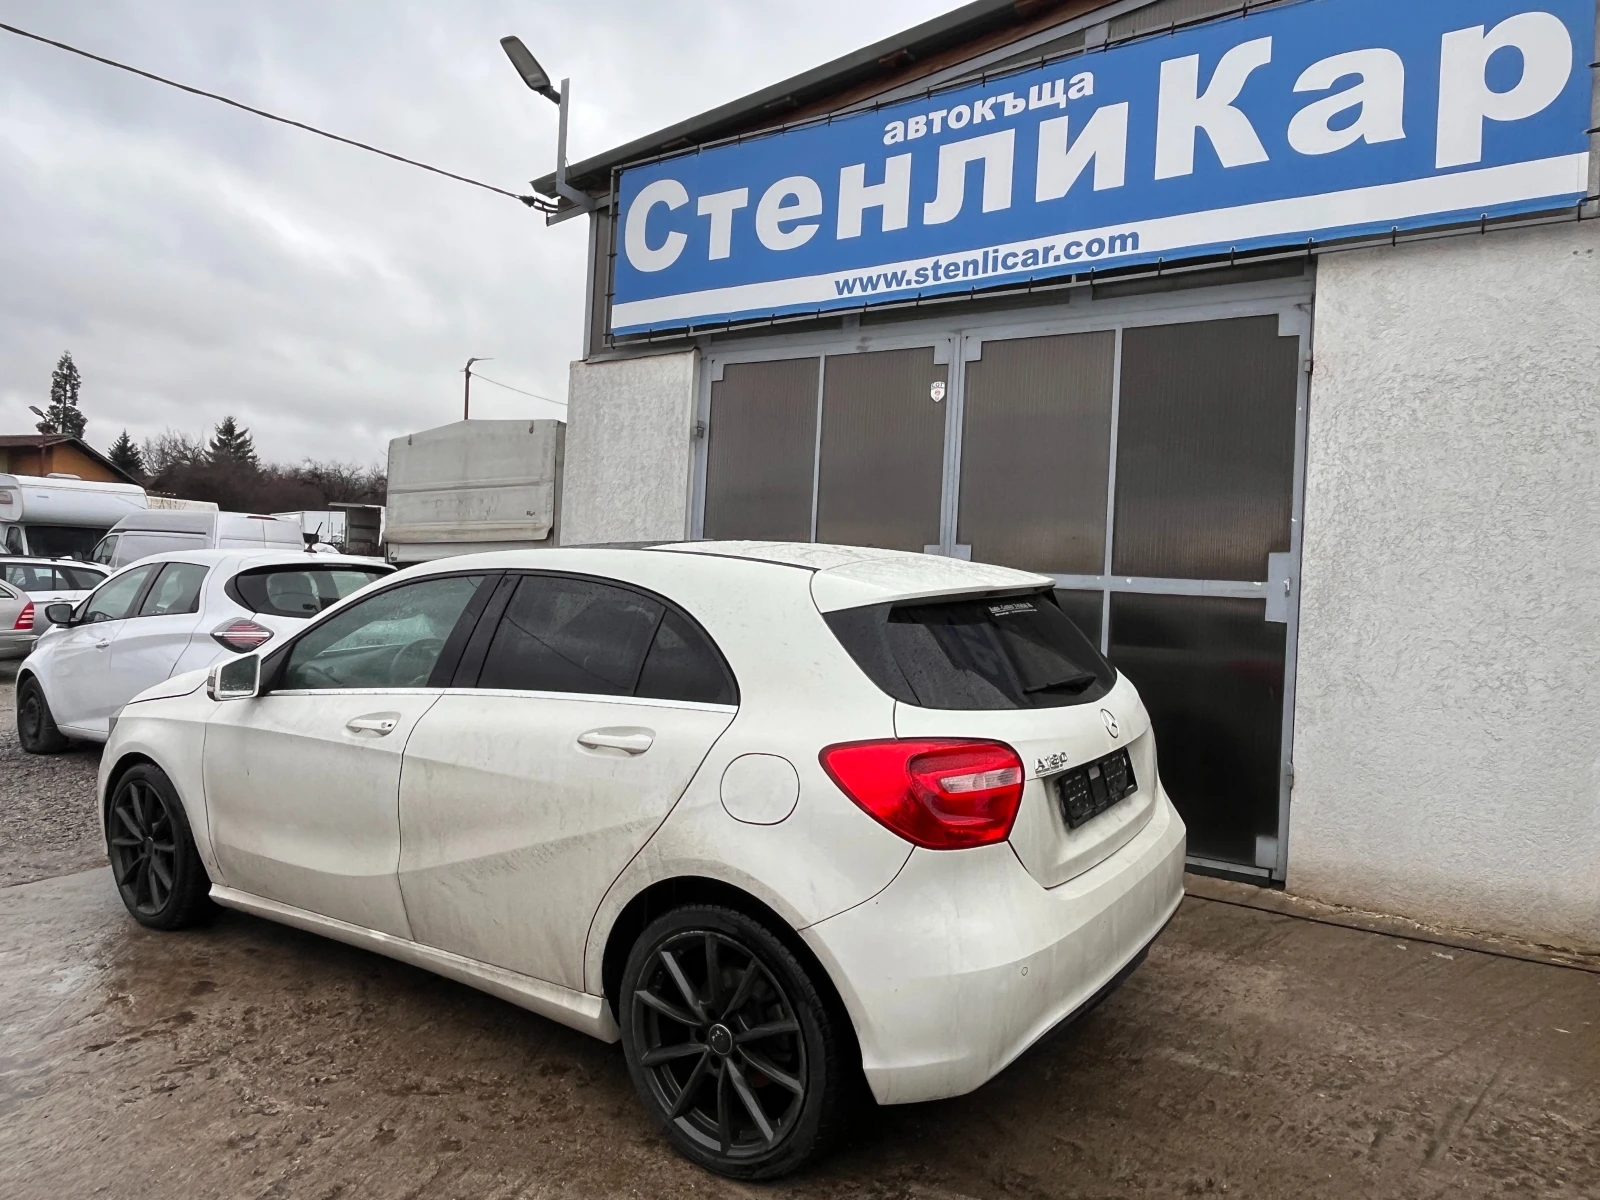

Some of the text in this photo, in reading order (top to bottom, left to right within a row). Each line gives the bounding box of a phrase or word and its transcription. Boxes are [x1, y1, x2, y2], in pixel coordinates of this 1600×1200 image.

[625, 12, 1572, 272] СтенлиКар
[883, 71, 1093, 146] автокъща
[835, 231, 1140, 296] www.stenlicar.com
